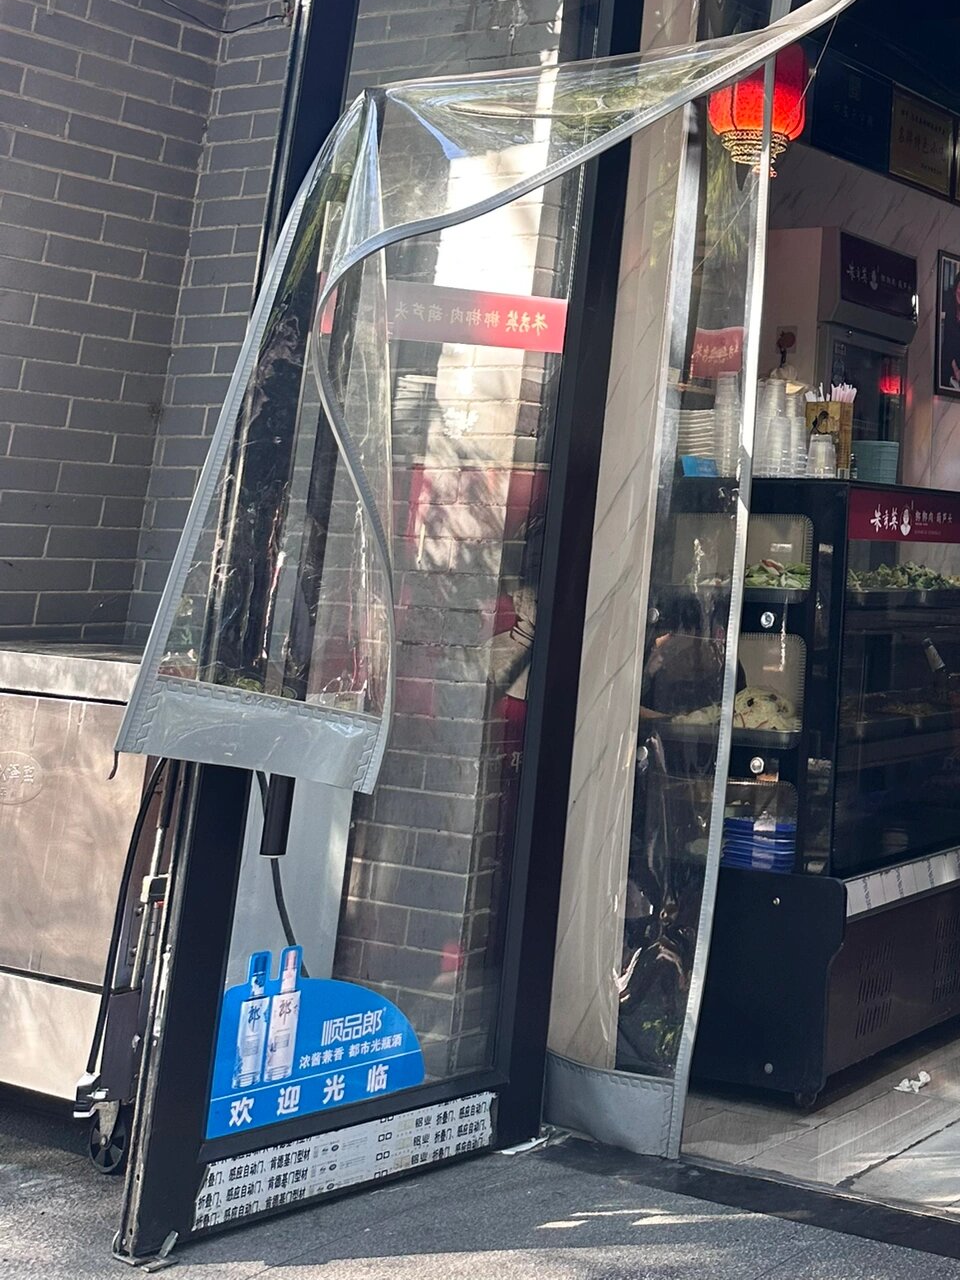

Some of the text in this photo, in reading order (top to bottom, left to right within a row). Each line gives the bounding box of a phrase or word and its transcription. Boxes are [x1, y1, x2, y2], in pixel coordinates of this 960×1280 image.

[320, 1008, 384, 1047] 顺品郎
[228, 1063, 390, 1127] 欢迎光临
